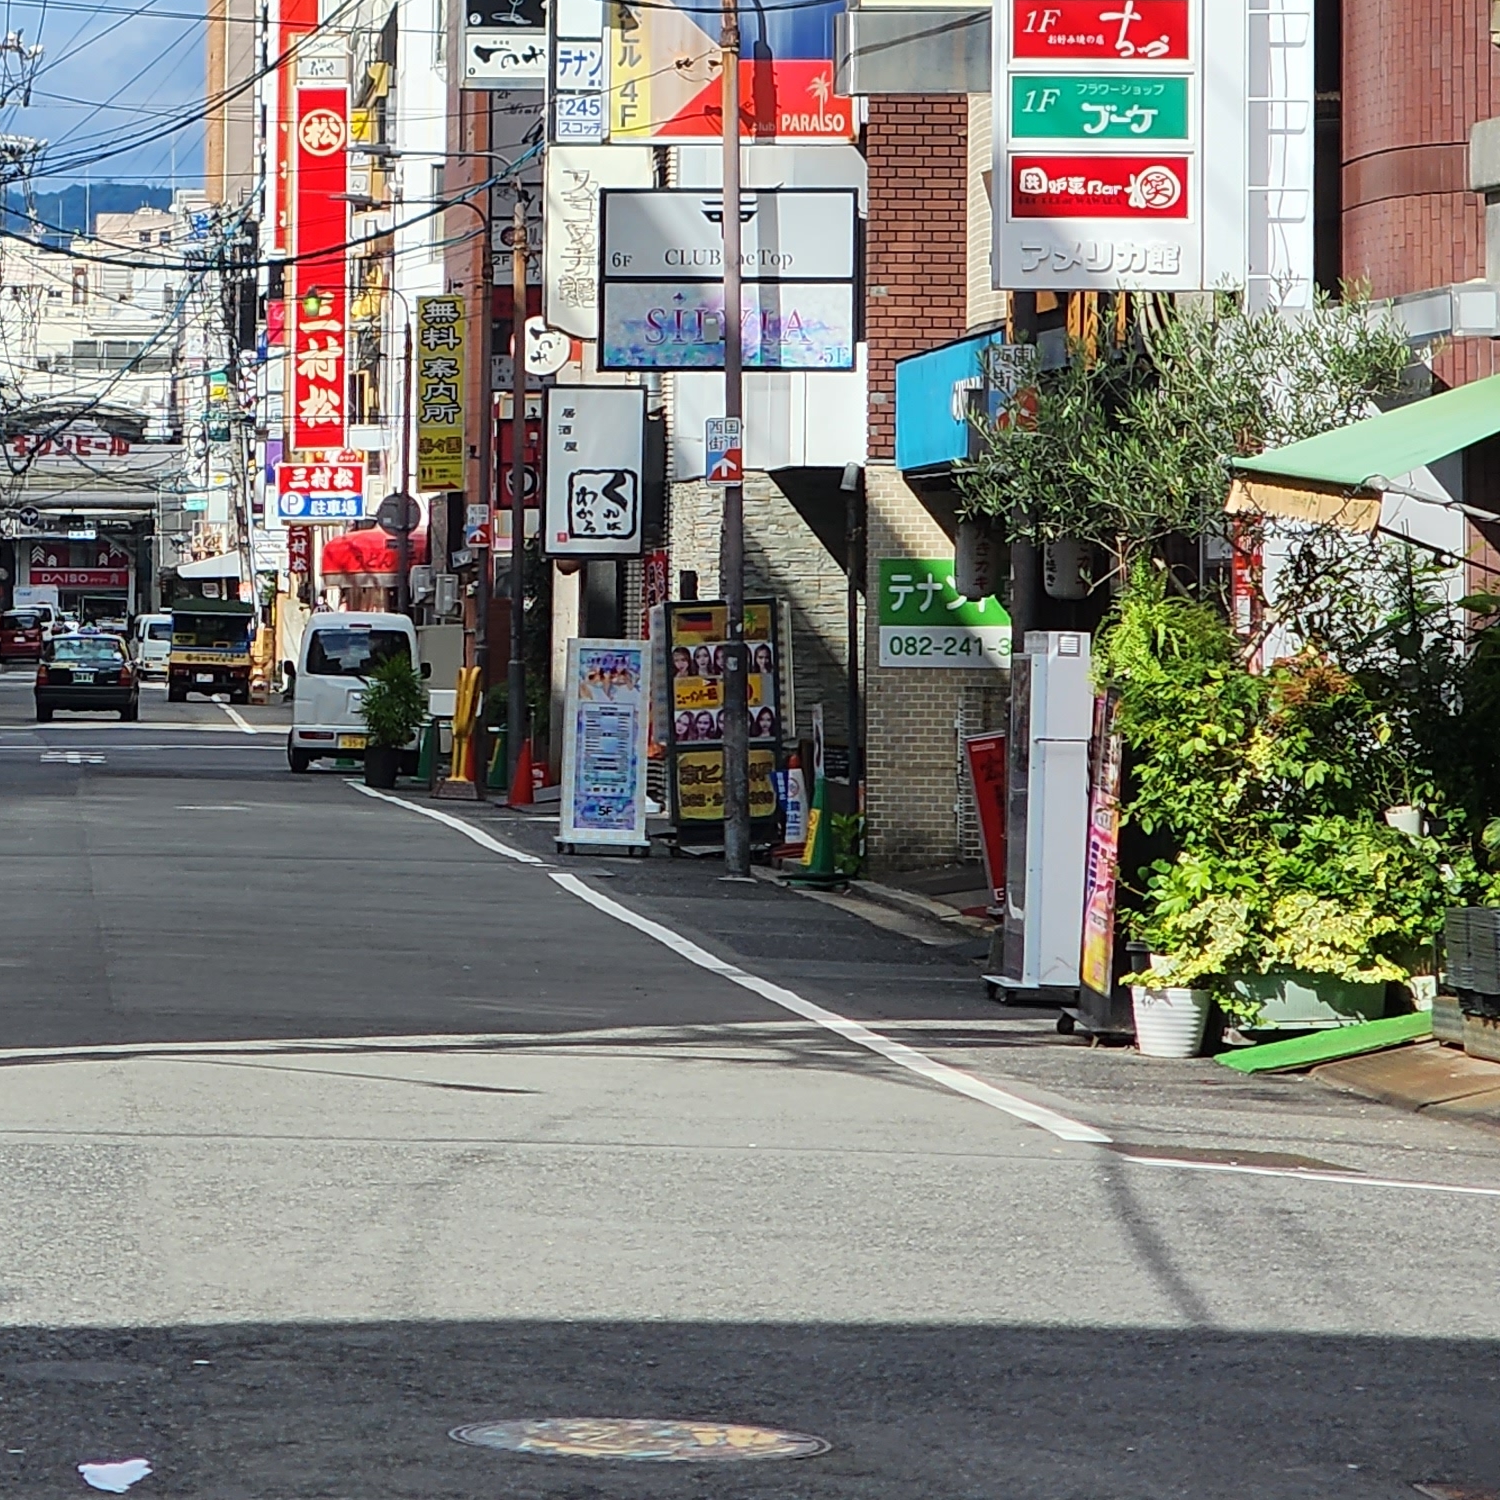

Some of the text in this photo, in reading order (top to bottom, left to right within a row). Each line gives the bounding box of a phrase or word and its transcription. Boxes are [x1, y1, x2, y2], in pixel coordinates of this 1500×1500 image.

[1022, 9, 1062, 33] 1F
[1021, 88, 1061, 113] 1F
[1076, 83, 1166, 96] フラワーショップ
[618, 80, 640, 127] 4F
[753, 113, 846, 133] club PARAISO
[1081, 102, 1159, 134] ブーケ
[306, 119, 344, 147] 松
[492, 256, 510, 266] 2F
[611, 251, 633, 268] 6F
[664, 249, 794, 271] CLUB Top
[1019, 241, 1181, 274] アメリカ館
[298, 290, 344, 429] 三村松
[421, 300, 461, 425] 無料案内所
[823, 347, 848, 364] 5F
[708, 419, 740, 435] 西国
[708, 435, 739, 451] 街道
[288, 467, 354, 489] 三村松
[287, 493, 300, 512] P
[41, 573, 88, 583] DAISO
